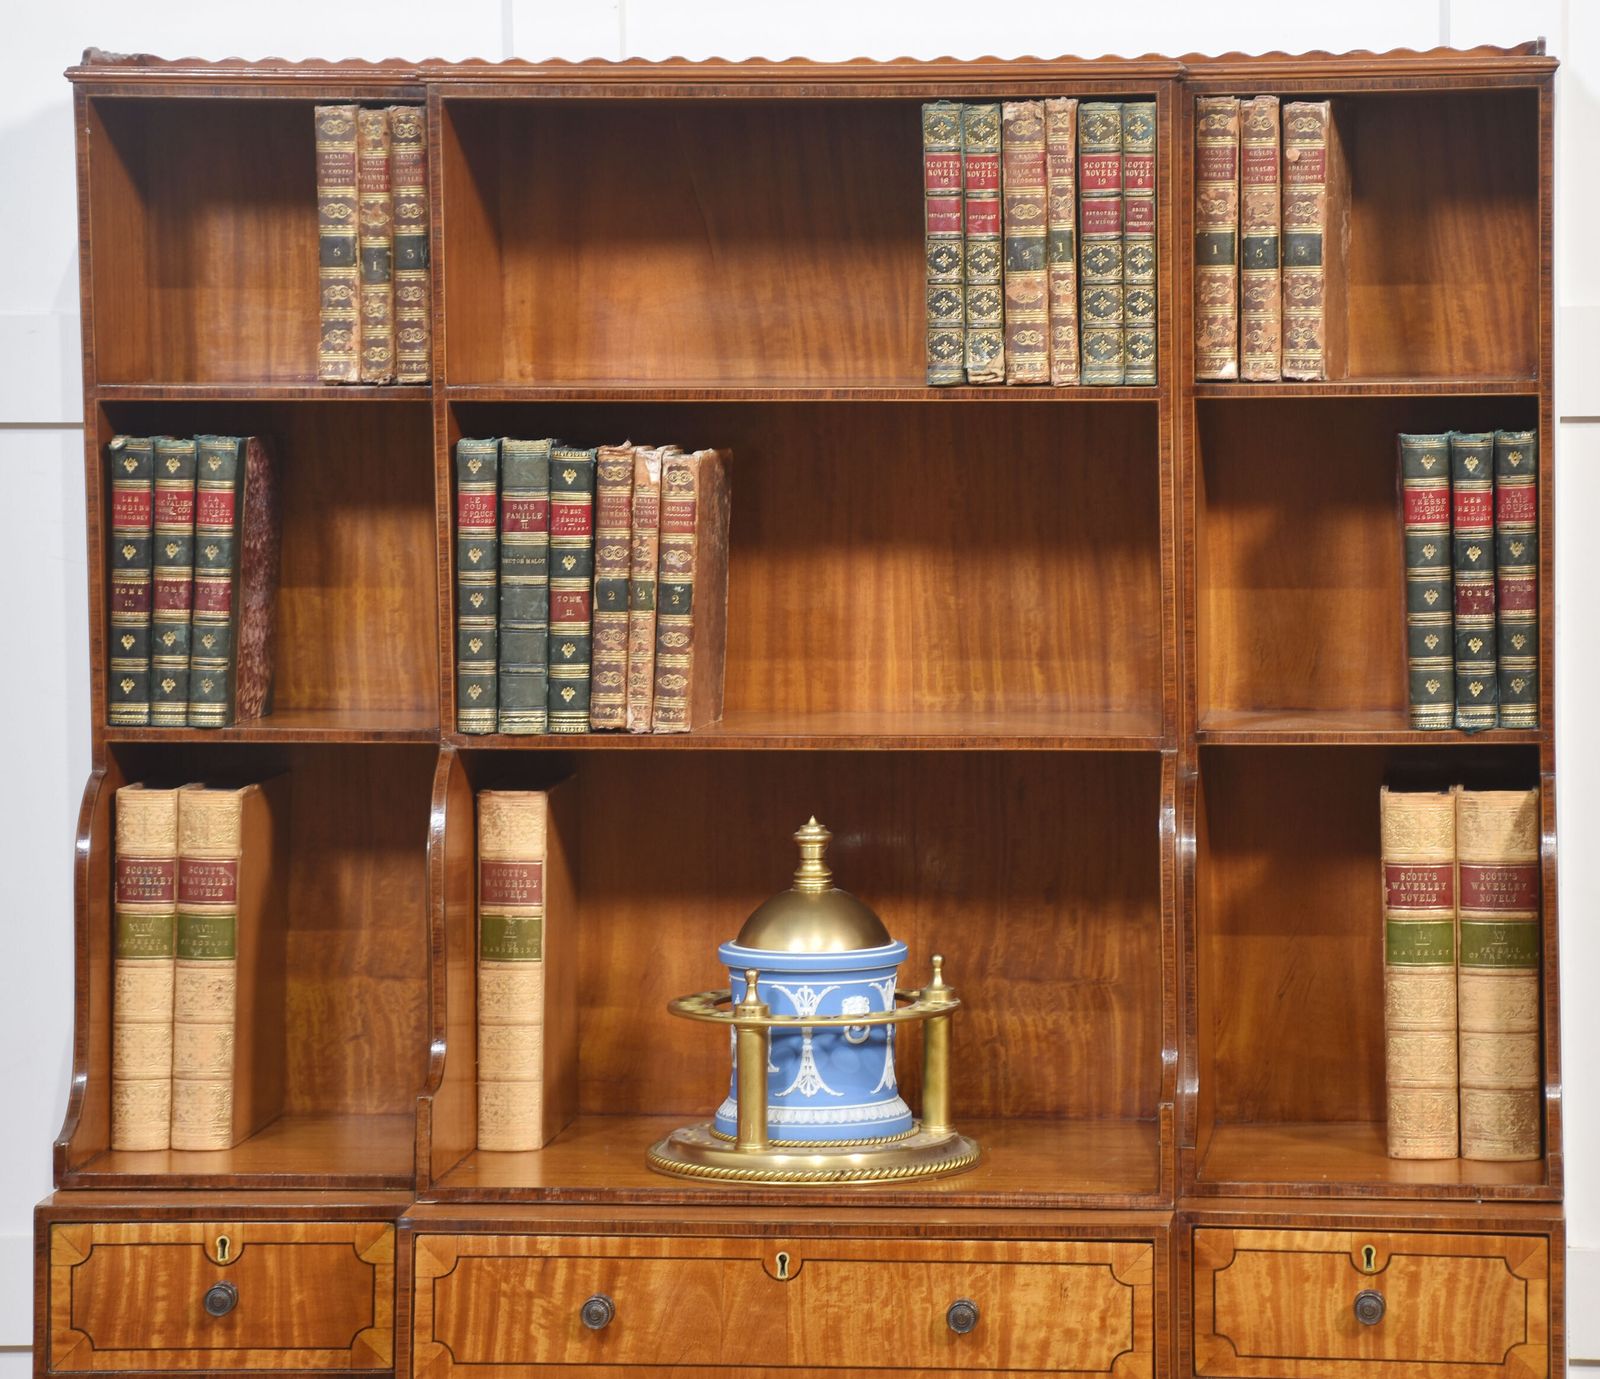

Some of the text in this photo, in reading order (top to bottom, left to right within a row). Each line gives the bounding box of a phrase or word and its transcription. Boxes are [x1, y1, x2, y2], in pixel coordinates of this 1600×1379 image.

[928, 169, 959, 177] NOVELS
[966, 169, 997, 177] NOVELS
[1086, 169, 1117, 177] NOVELS
[1097, 177, 1106, 185] 19
[1058, 242, 1063, 252] 1
[1213, 244, 1218, 255] 1
[373, 261, 377, 270] 1
[608, 592, 615, 600] 2
[639, 592, 646, 600] 2
[672, 595, 679, 604] 2
[126, 866, 162, 875] SCOTT'S
[189, 867, 224, 875] SCOTT'S
[492, 869, 528, 877] SCOTT'S
[1400, 872, 1437, 881] SCOTT'S
[1480, 873, 1518, 881] SCOTT'S
[120, 877, 173, 885] WAVERLEY
[182, 877, 234, 886] WAVERLEY
[1392, 882, 1447, 890] WAVERLEY
[1471, 882, 1527, 890] WAVERLEY
[127, 887, 162, 896] NOVELS
[188, 888, 224, 896] NOVELS
[494, 890, 528, 898] NOVELS
[1401, 894, 1437, 902] NOVELS
[1480, 894, 1517, 902] NOVELS
